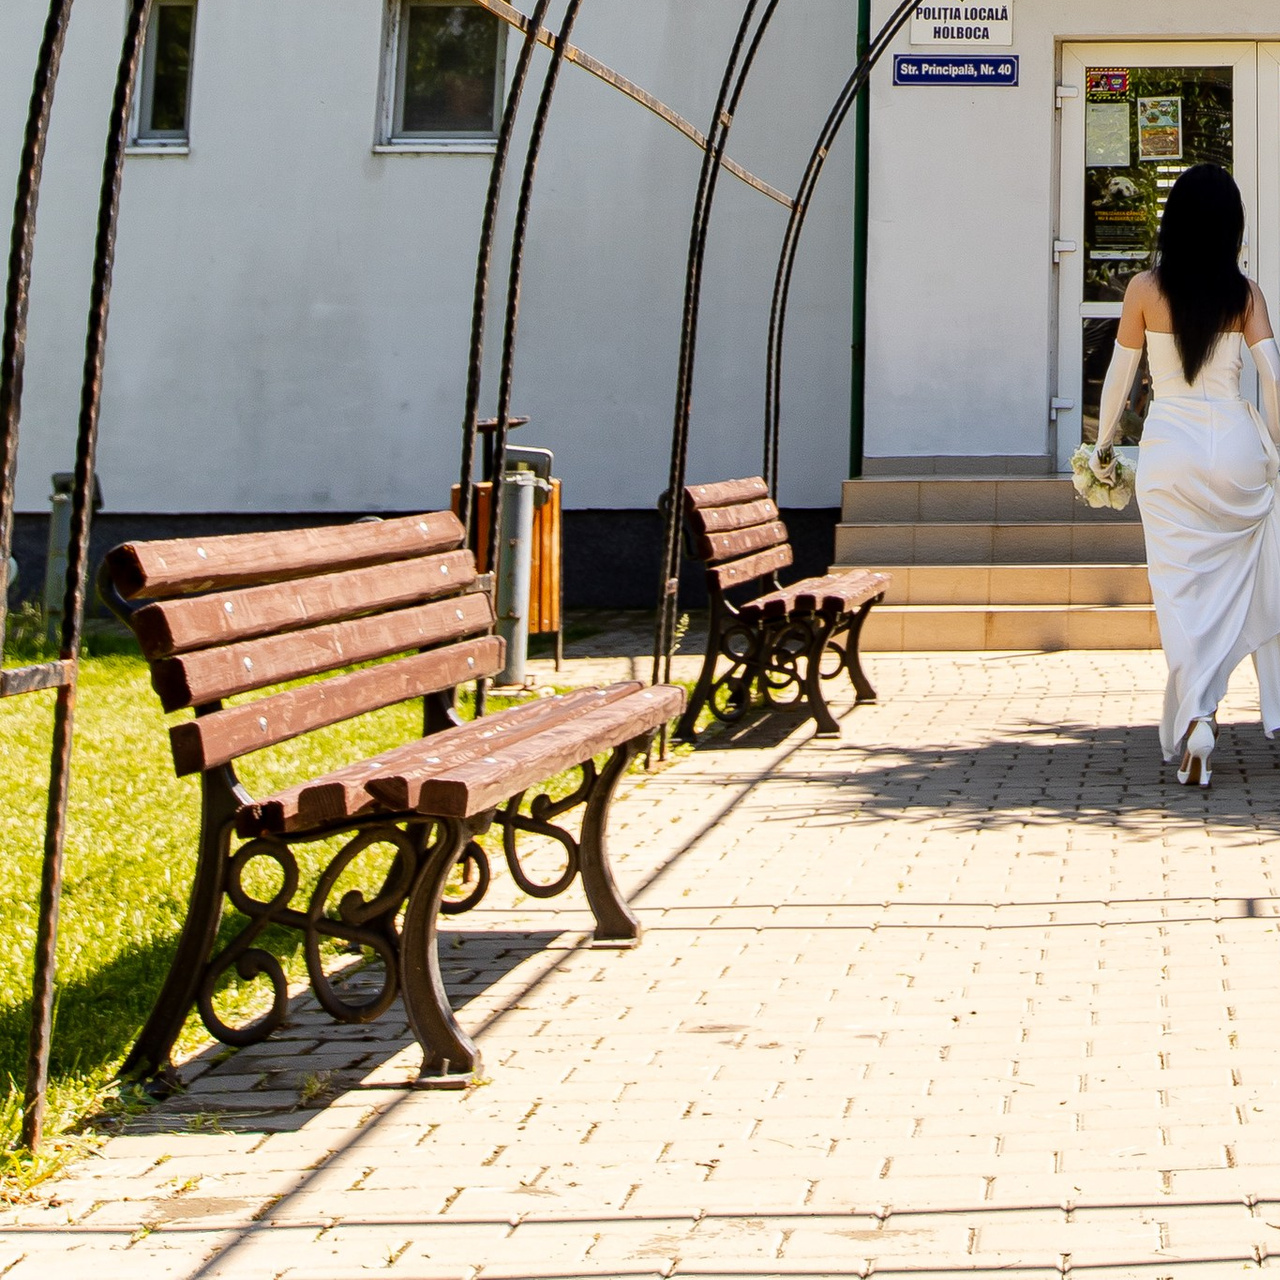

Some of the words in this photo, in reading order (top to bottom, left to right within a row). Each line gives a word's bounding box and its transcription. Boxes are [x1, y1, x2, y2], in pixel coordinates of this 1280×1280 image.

[965, 5, 1008, 21] LOCALĂ
[933, 26, 989, 40] HOLBOCA
[900, 63, 919, 75] Str.
[921, 63, 978, 77] Principală,
[980, 64, 995, 75] Nr.
[997, 64, 1012, 75] 40
